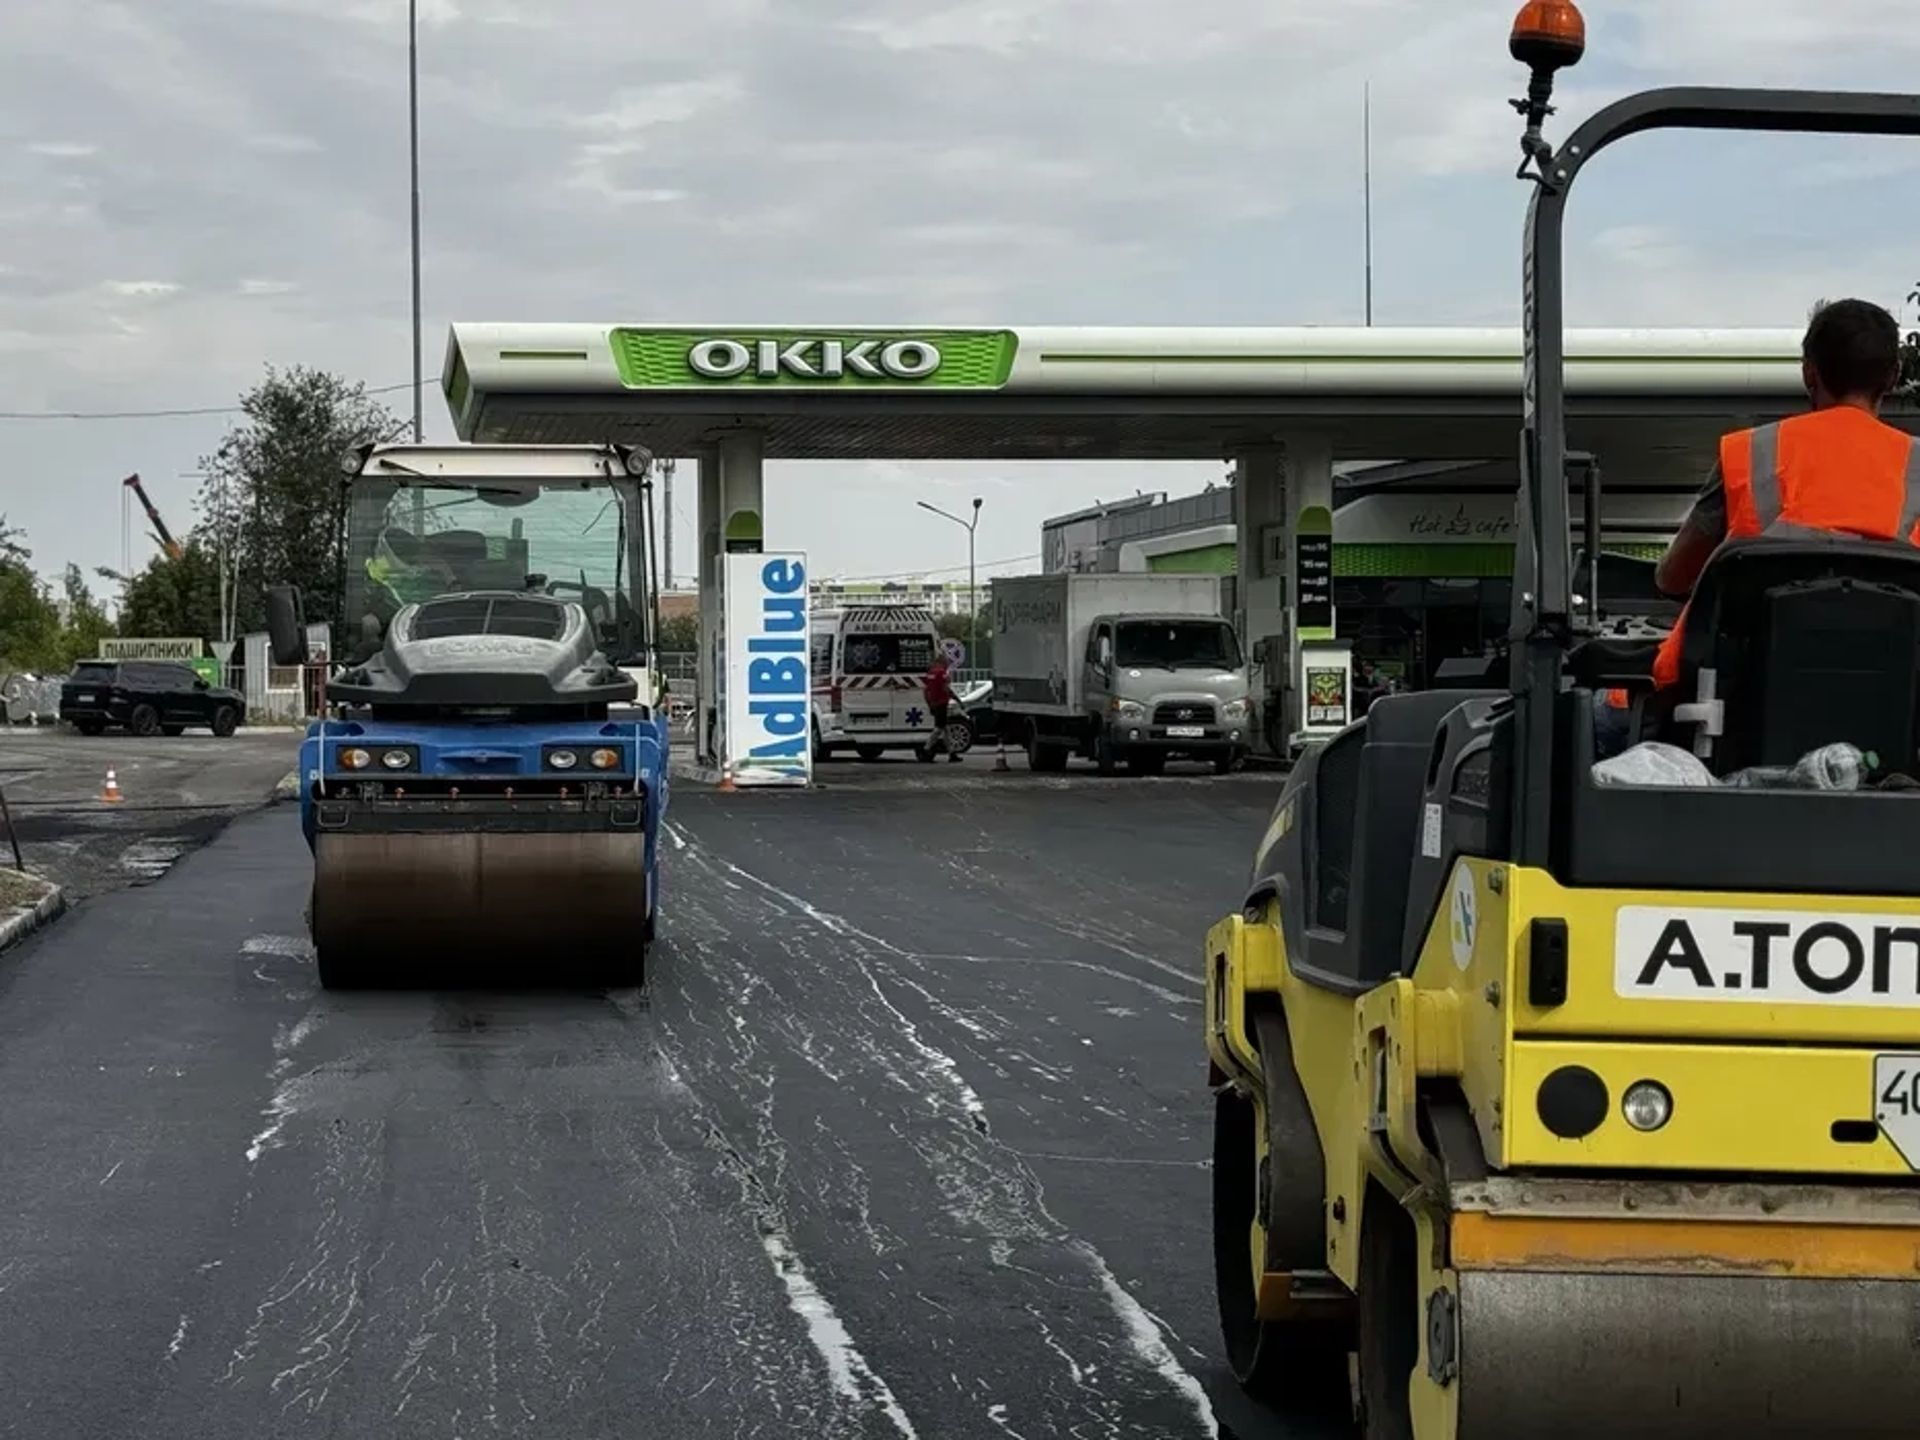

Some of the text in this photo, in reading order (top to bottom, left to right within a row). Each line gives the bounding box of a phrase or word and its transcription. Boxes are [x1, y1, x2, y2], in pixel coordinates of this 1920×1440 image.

[688, 340, 941, 379] OKKO
[1409, 514, 1441, 533] Hot
[855, 623, 923, 632] AMBULANCE
[105, 642, 193, 658] ПІДШИПНИКИ
[749, 558, 807, 776] AdBlue
